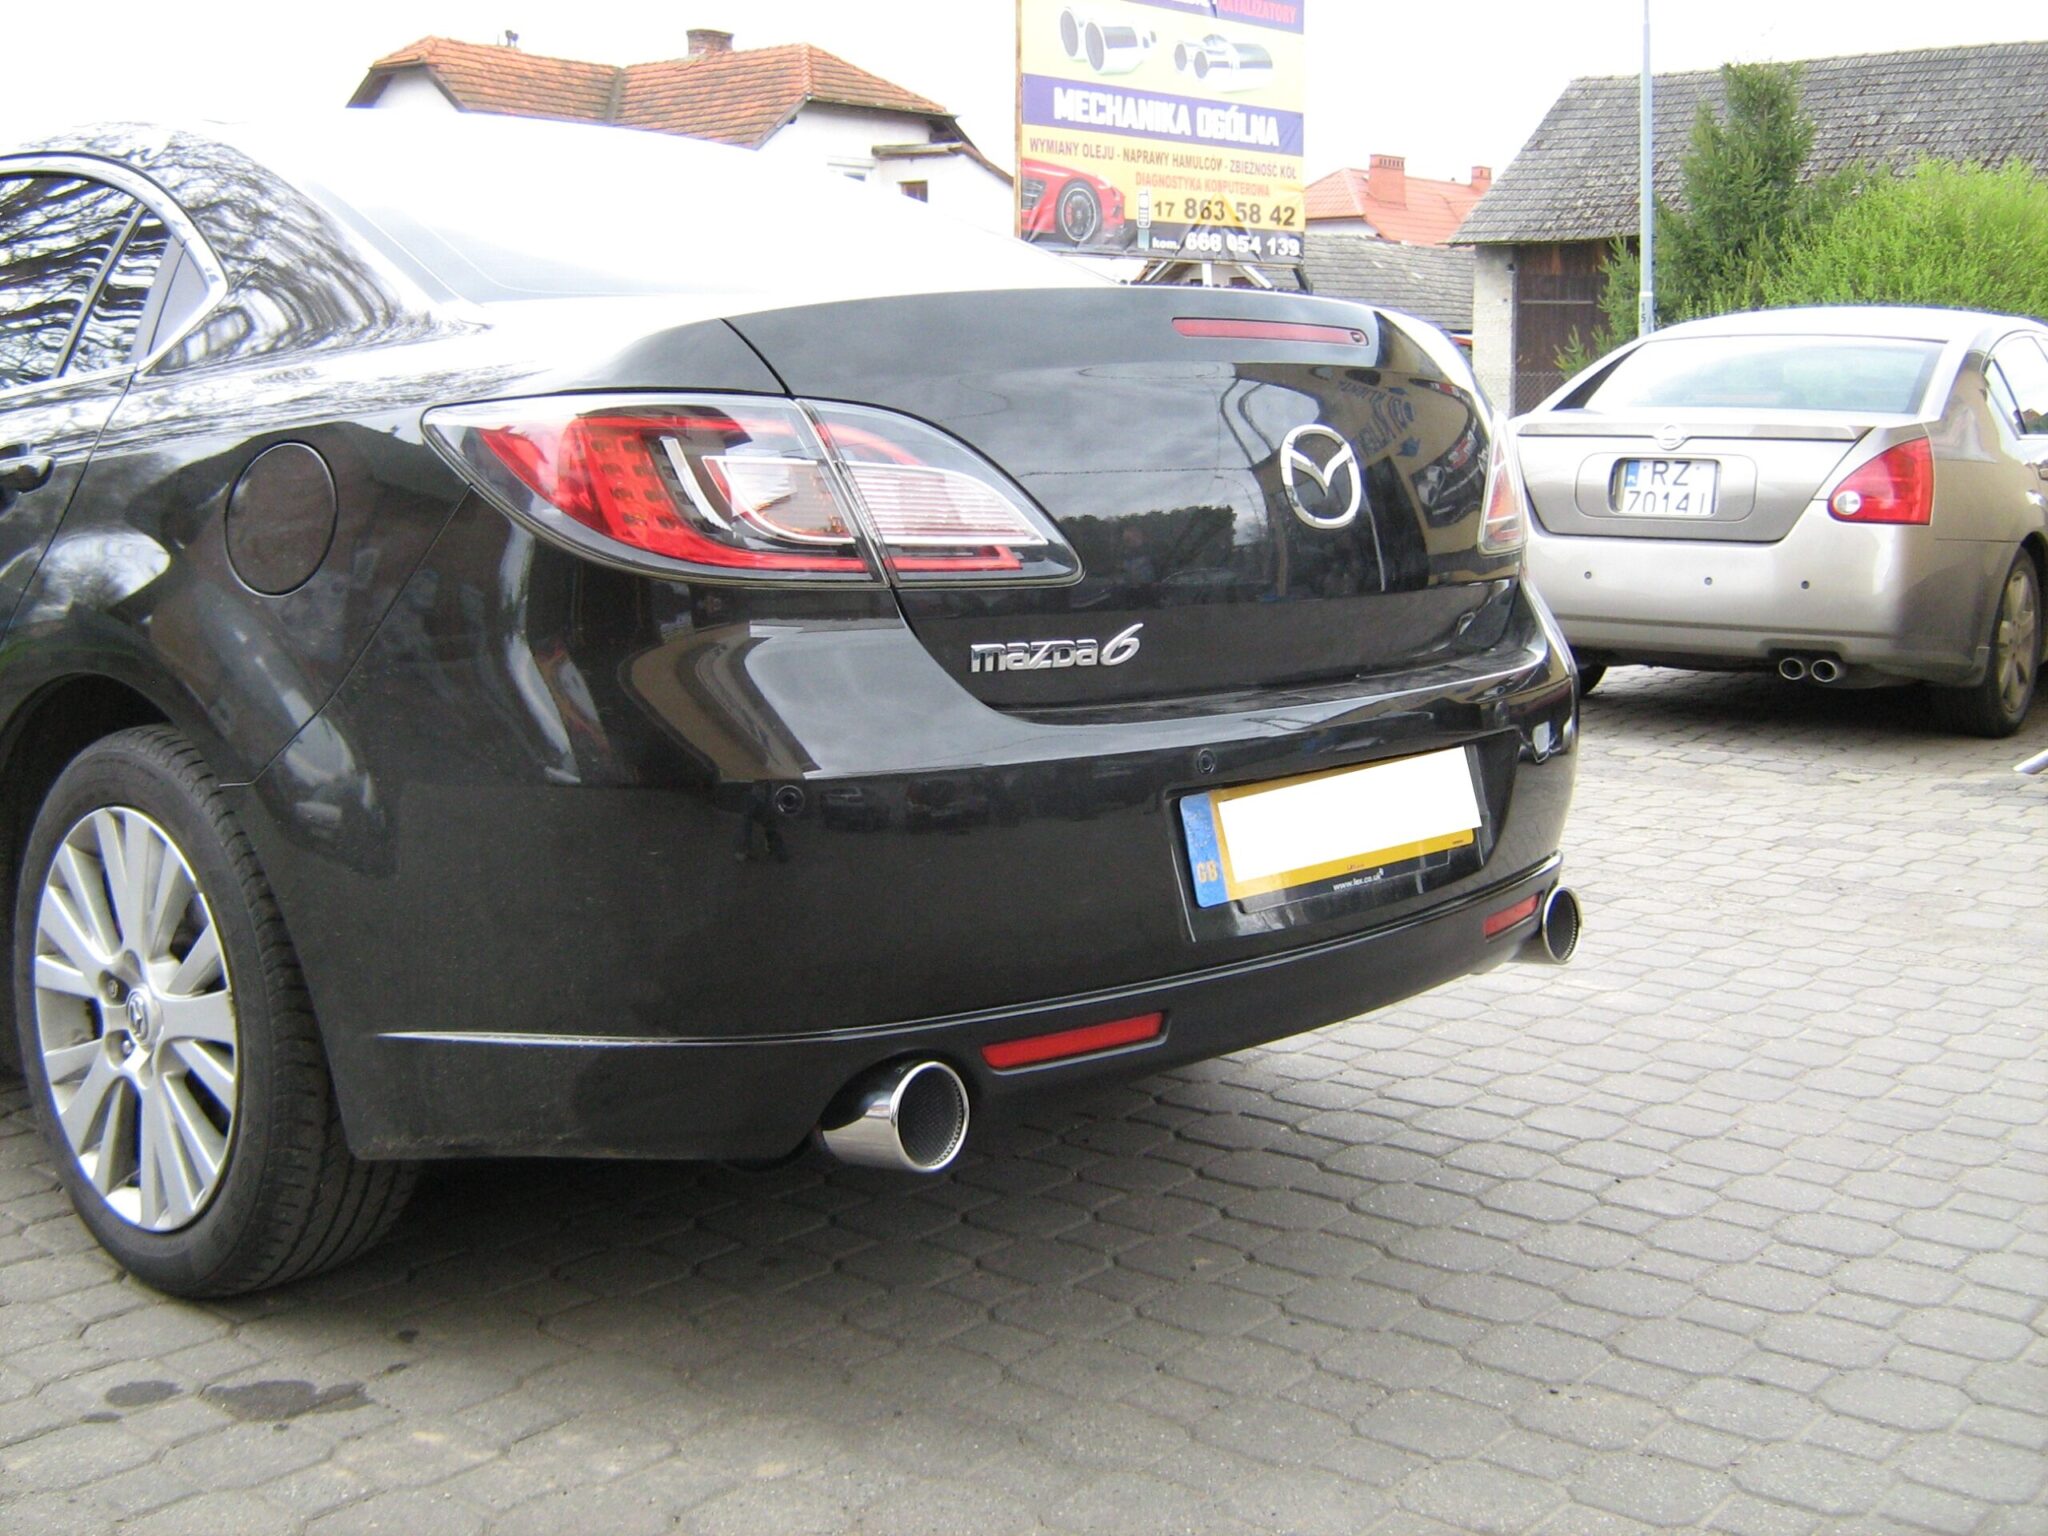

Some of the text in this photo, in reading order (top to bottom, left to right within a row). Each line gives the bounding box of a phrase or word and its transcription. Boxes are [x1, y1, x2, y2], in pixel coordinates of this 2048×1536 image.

[1054, 87, 1280, 146] MECHANIKA OGÓLNA
[1029, 137, 1079, 156] WYMIANY
[1082, 143, 1115, 160] OLEJU
[1123, 147, 1170, 166] NAPRAWY
[1135, 171, 1271, 197] DIAGNOSTYKA KOMPUTEROWA
[1154, 198, 1296, 226] 17 863 58 42
[1266, 236, 1300, 256] 139
[1651, 460, 1692, 486] RZ
[1627, 490, 1705, 514] 70141
[1197, 861, 1218, 882] GB
